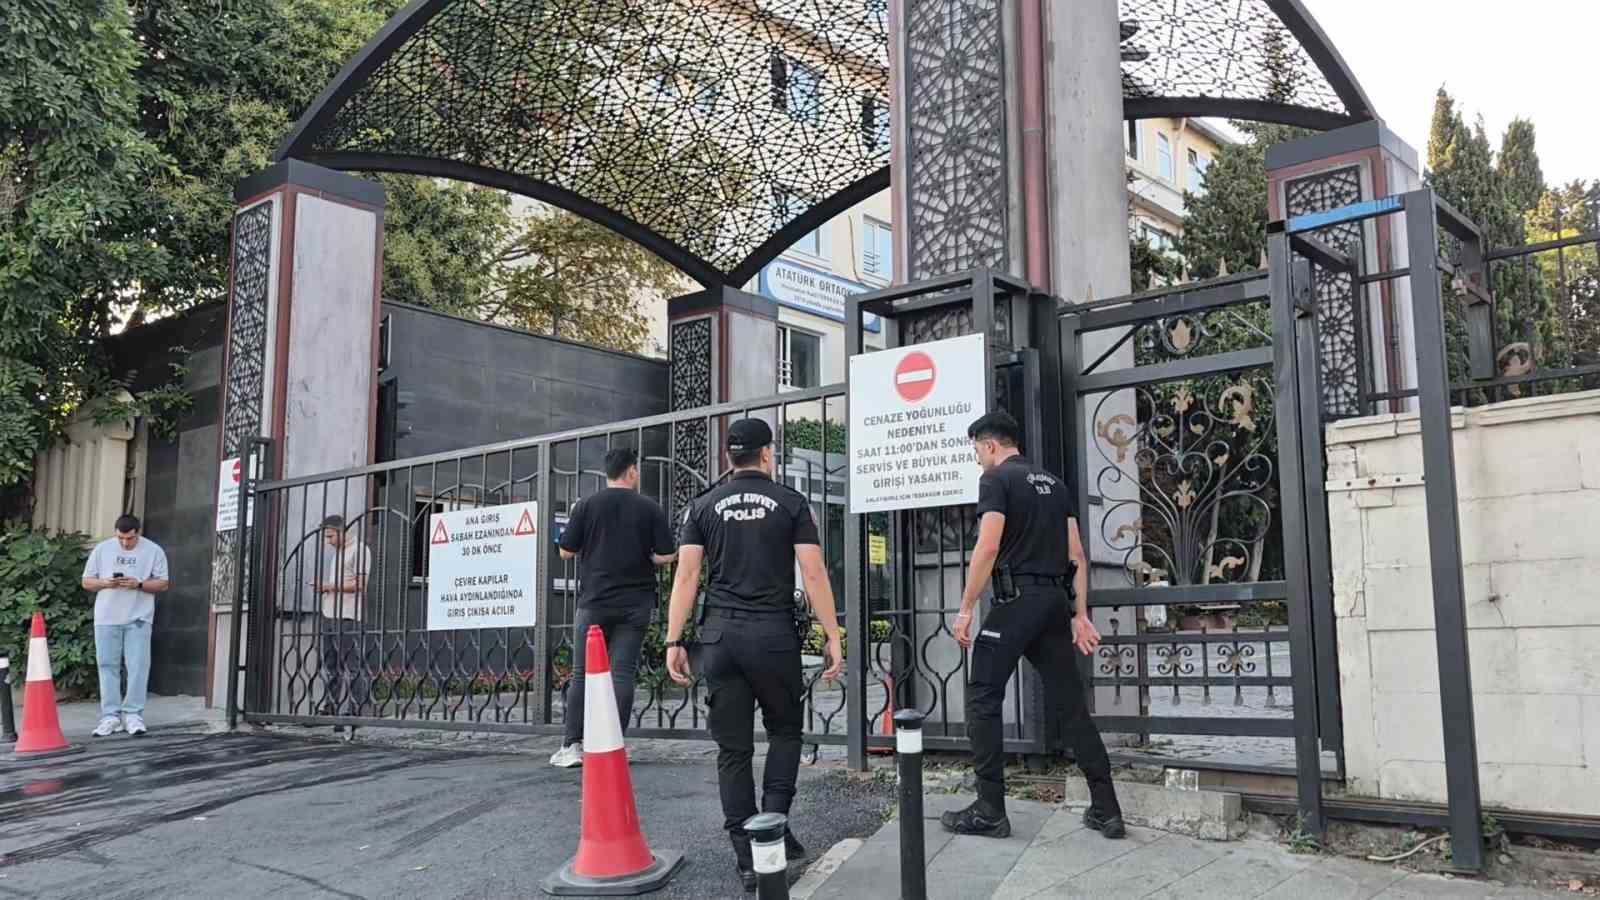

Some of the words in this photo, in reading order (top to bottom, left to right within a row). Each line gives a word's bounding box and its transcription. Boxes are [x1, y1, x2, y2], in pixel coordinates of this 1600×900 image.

[863, 412, 904, 428] CENAZE
[905, 400, 971, 421] YOĞUNLUĞU
[887, 421, 946, 440] NEDENİYLE
[857, 446, 881, 459] SAAT
[885, 440, 938, 456] 11:00'DAN
[941, 434, 974, 449] SONR
[855, 460, 894, 476] SERVİS
[895, 459, 910, 471] VE
[912, 452, 948, 468] BÜYÜK
[873, 472, 905, 489] GİRİŞİ
[907, 469, 963, 486] YASAKTIR.
[743, 492, 778, 513] KUVVET
[465, 514, 479, 526] ANA
[450, 530, 474, 543] SABAH
[474, 527, 515, 541] EZANINDAN
[462, 545, 471, 556] 30
[471, 544, 482, 555] DK
[478, 573, 509, 586] KAPILAR
[440, 591, 458, 602] HAVA
